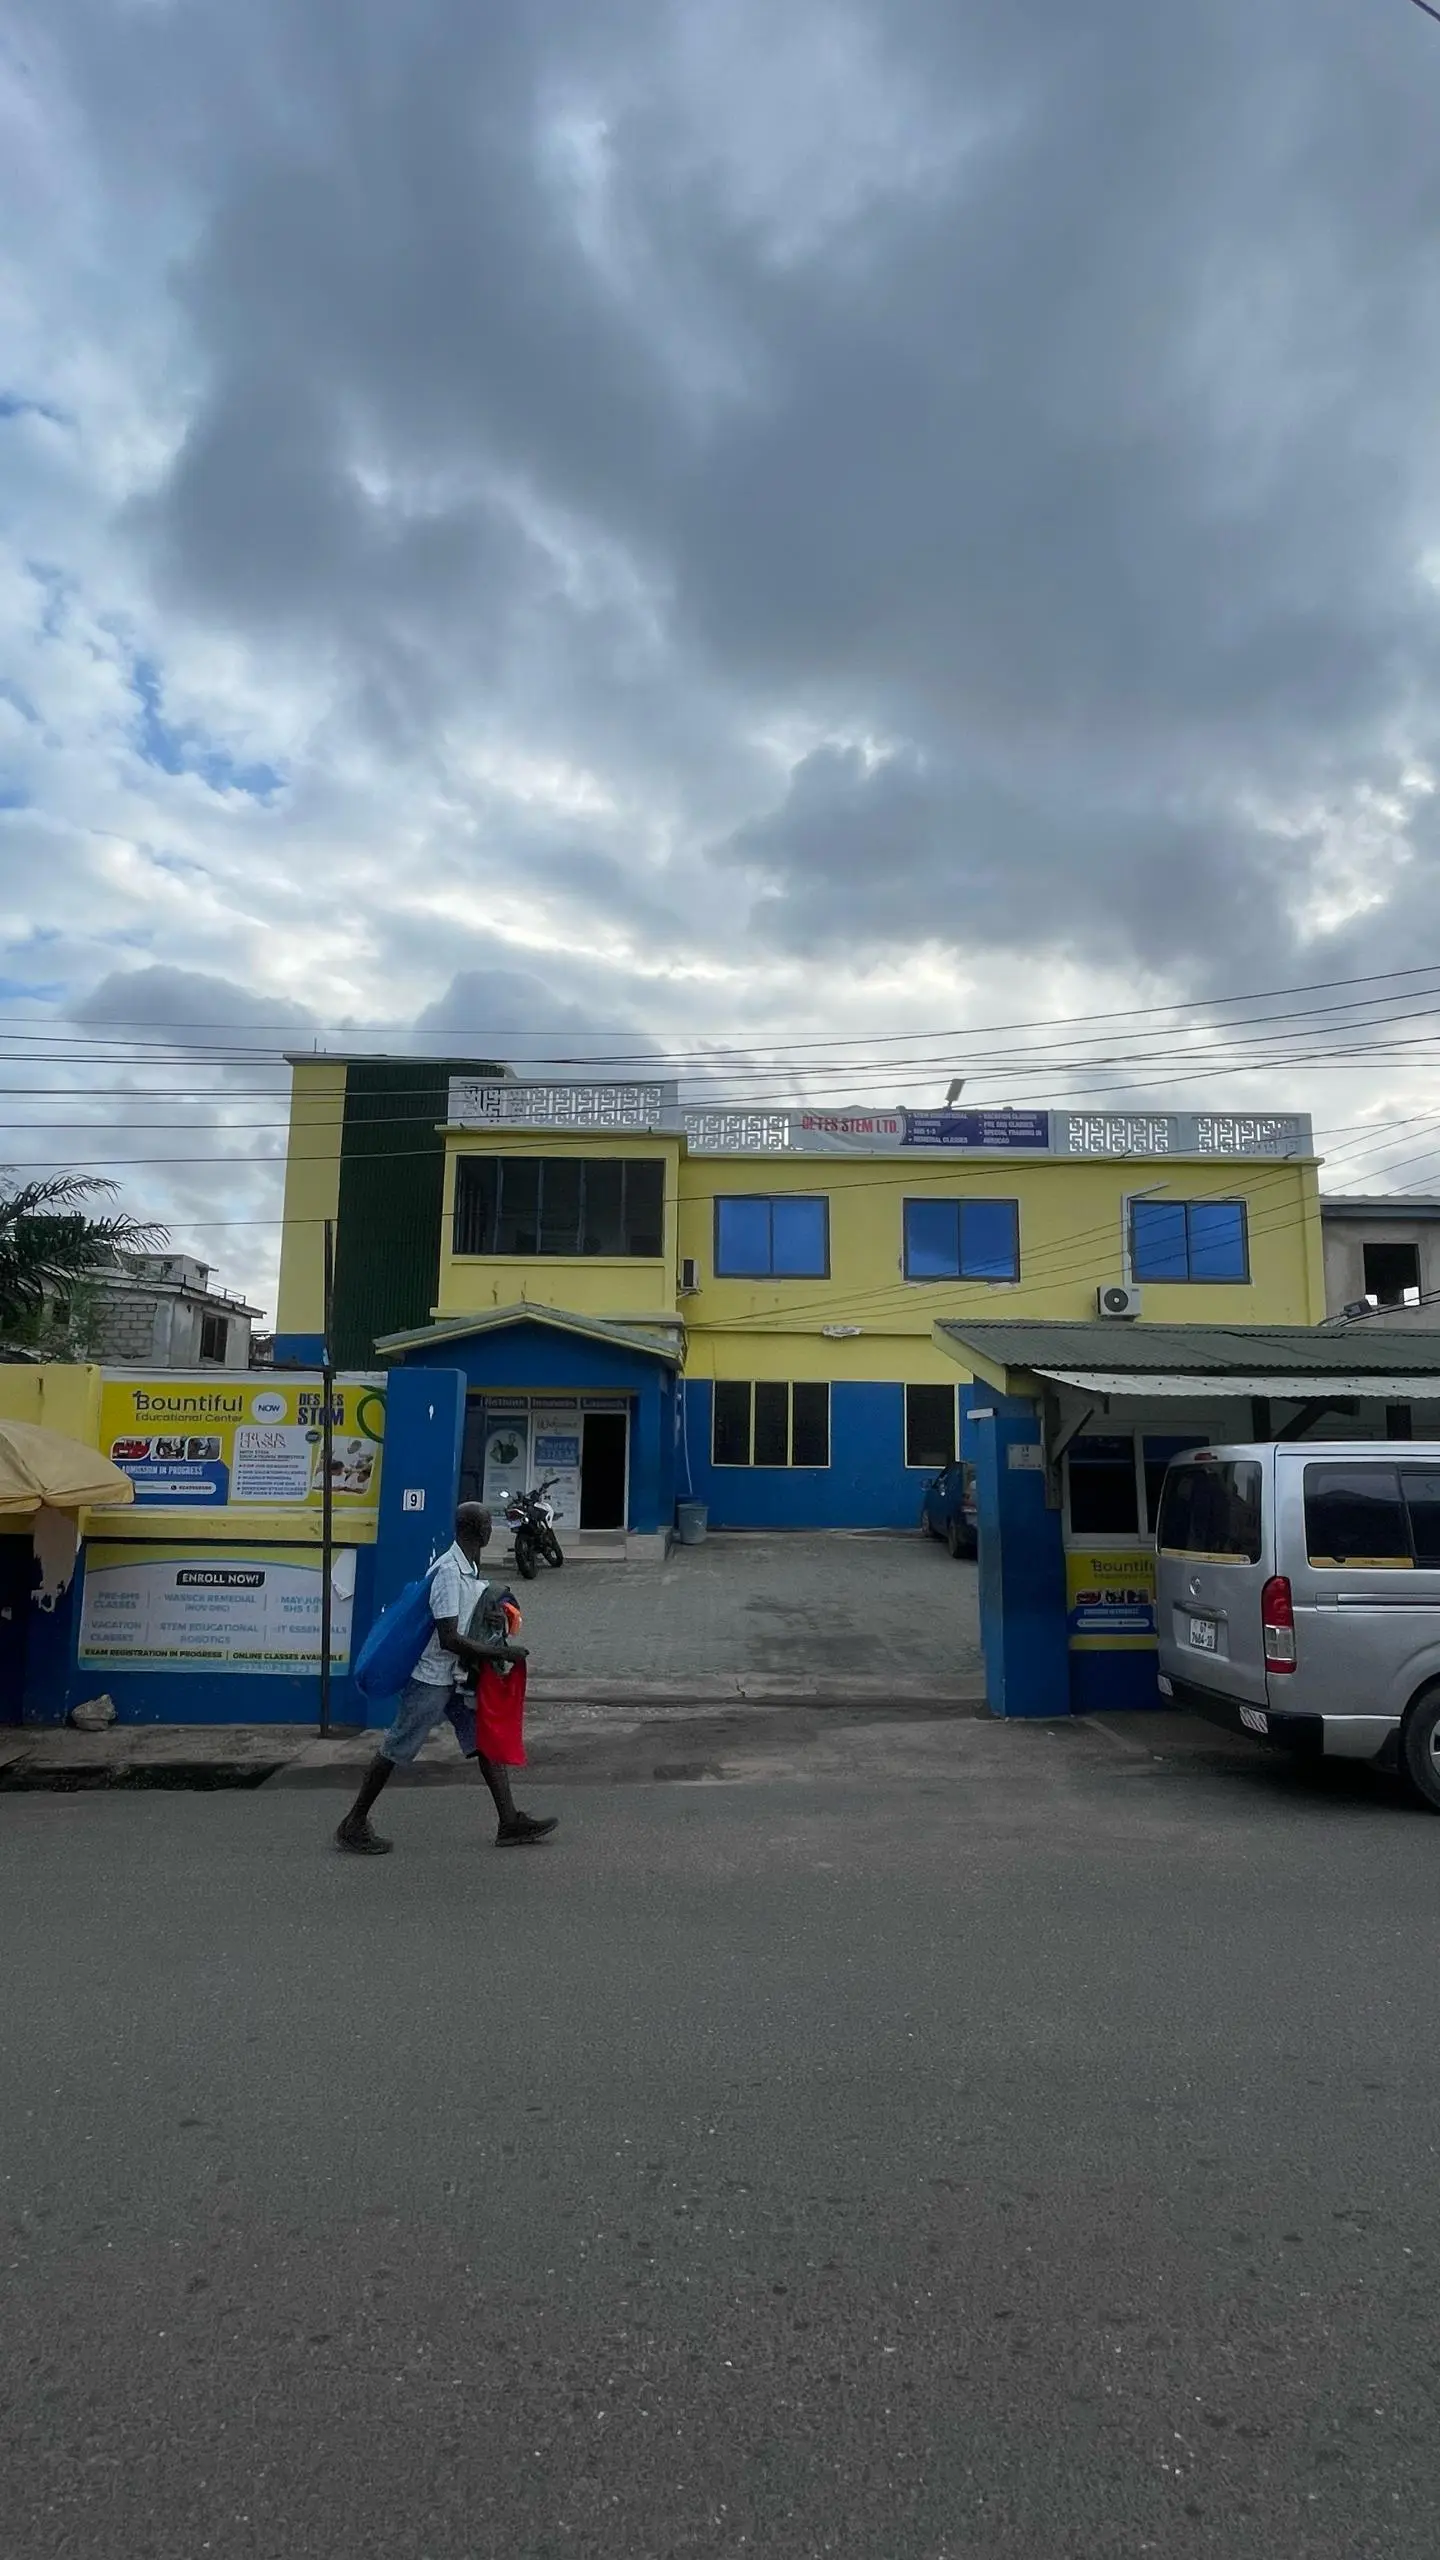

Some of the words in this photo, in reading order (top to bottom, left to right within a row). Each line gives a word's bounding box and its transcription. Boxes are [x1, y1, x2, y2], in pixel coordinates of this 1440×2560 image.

[841, 1118, 873, 1132] STEM
[136, 1393, 243, 1412] Bountiful
[135, 1413, 202, 1422] Educational
[205, 1414, 243, 1422] Center
[159, 1465, 168, 1475] IN
[168, 1465, 203, 1476] PROGRESS
[410, 1493, 418, 1507] 9
[1093, 1560, 1153, 1572] Bountif
[181, 1573, 225, 1584] ENROLL
[228, 1574, 260, 1585] NOW!
[207, 1594, 257, 1603] REMEDIAL
[93, 1600, 137, 1609] CLASSES
[283, 1605, 304, 1613] SHS
[91, 1620, 142, 1629] VACATION
[160, 1622, 187, 1631] STEM
[189, 1623, 260, 1633] EDUCATIONAL
[90, 1633, 134, 1641] CLASSES
[180, 1635, 231, 1645] ROBOTICS
[85, 1648, 108, 1656] EXAM
[109, 1648, 168, 1657] REGISTRATION
[179, 1650, 223, 1658] PROGRESS
[232, 1652, 263, 1660] ONLINE
[264, 1652, 299, 1660] CLASSES
[300, 1653, 343, 1661] AVAIBLE
